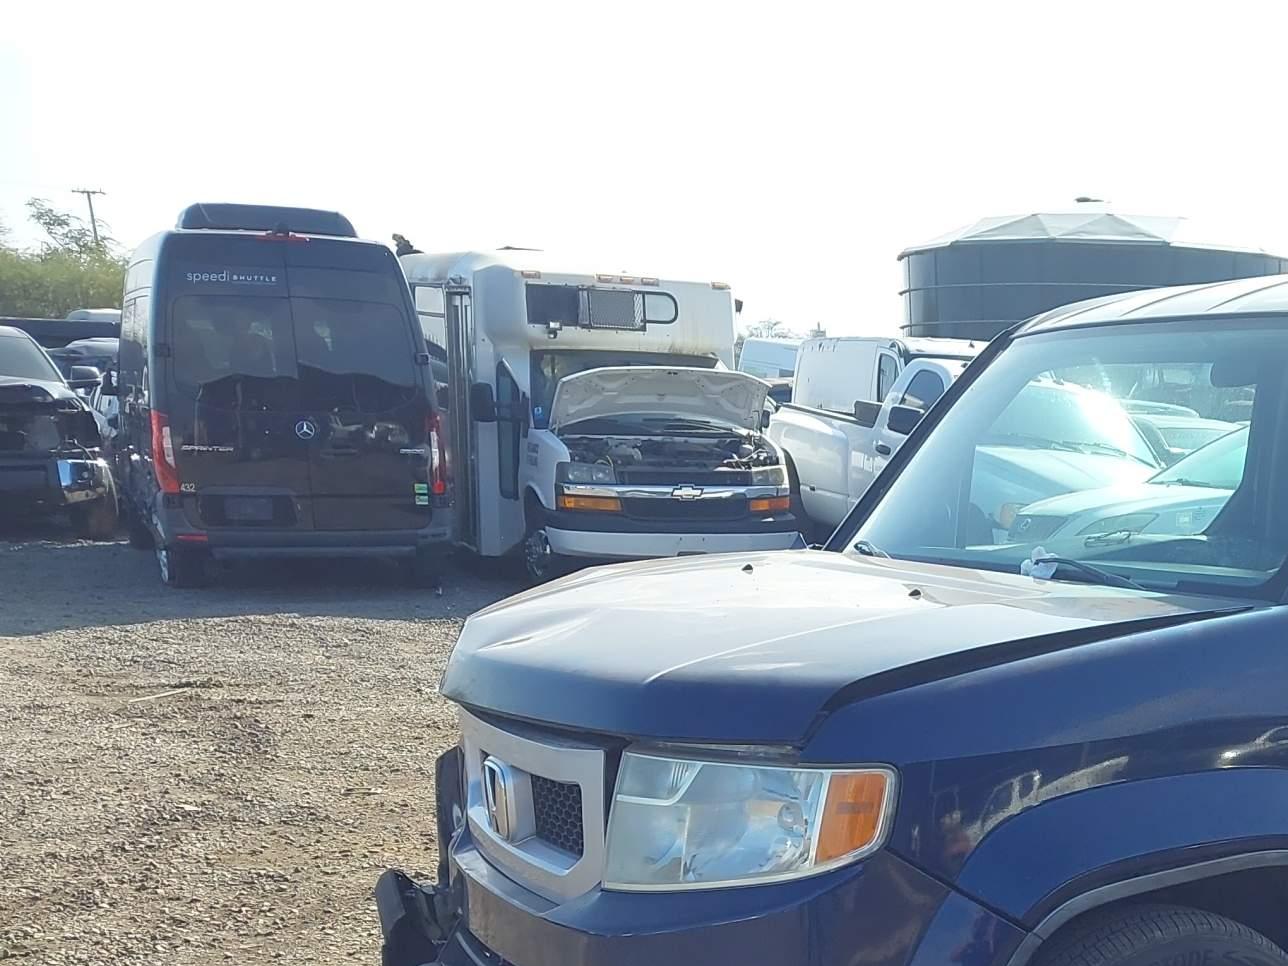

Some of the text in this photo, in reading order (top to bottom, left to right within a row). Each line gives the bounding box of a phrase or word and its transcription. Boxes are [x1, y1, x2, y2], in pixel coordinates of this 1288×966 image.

[186, 269, 277, 285] speedi SHUTTLE
[180, 483, 196, 492] 432
